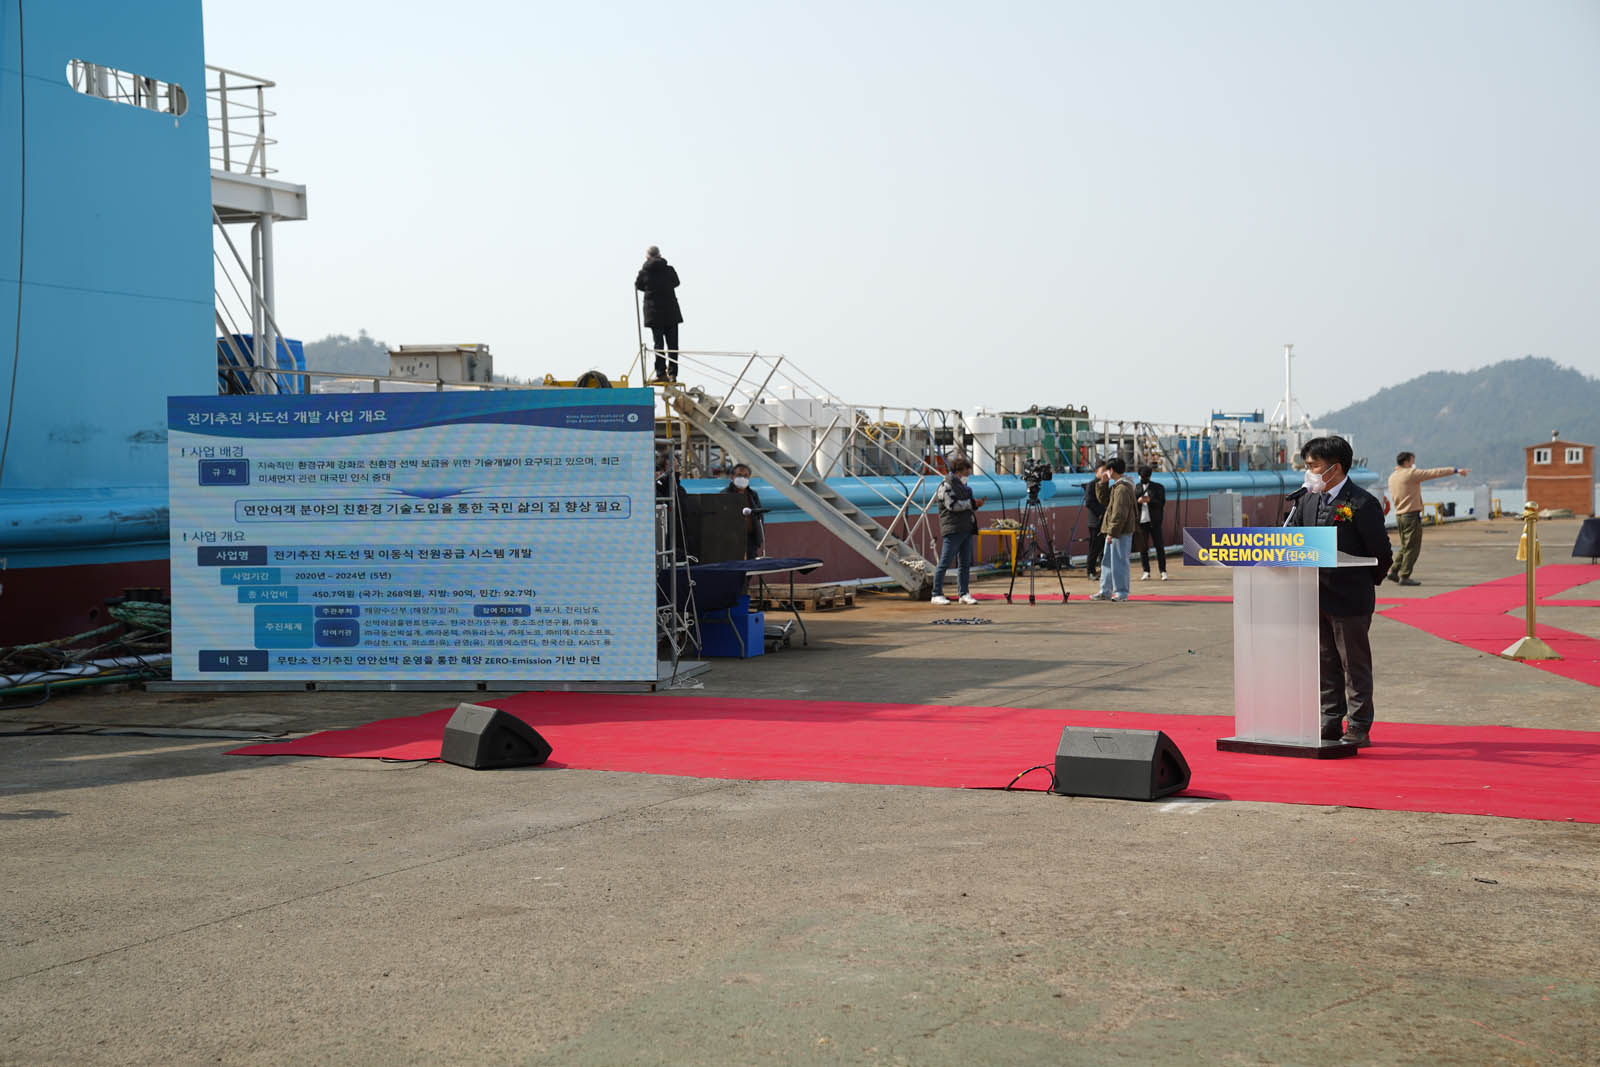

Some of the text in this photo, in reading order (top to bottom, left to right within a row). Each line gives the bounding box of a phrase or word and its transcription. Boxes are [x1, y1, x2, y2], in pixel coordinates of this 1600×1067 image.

[187, 409, 387, 425] 전기추진 차도선 개발 사업 개요
[190, 446, 244, 458] 사업 배경
[258, 456, 620, 470] 지속적인 환경규제 강화로 친환경 선박 보급을 위한 기술개발이 요구되고 있으며, 최근
[259, 473, 391, 483] 미세먼지 관련 대국민 인식 증대
[244, 501, 622, 516] 연안여객 분야의 친환경 기술도입을 통한 국민 삶의 질 향상 필요
[192, 530, 246, 543] 사업 개요
[1211, 533, 1305, 547] LAUNCHING
[216, 551, 249, 561] 사업명
[274, 548, 532, 561] 전기추진 차도선 및 이동식 전원공급 시스템 개발
[232, 572, 270, 581] 사업기간
[295, 572, 326, 580] 2020년
[335, 571, 366, 580] 2024년
[370, 571, 392, 580] (5년)
[261, 590, 288, 599] 사업비
[312, 590, 355, 599] 450.7억원
[359, 590, 385, 599] (국가:
[428, 589, 450, 599] 지방:
[453, 589, 476, 599] 90억,
[479, 589, 501, 598] 민간:
[503, 589, 536, 598] 92.7억)
[265, 622, 303, 632] 추진체계
[277, 655, 600, 665] 무탄소 전기추진 연안선박 운영을 통한 해양 ZERO-Emission 기반 마련
